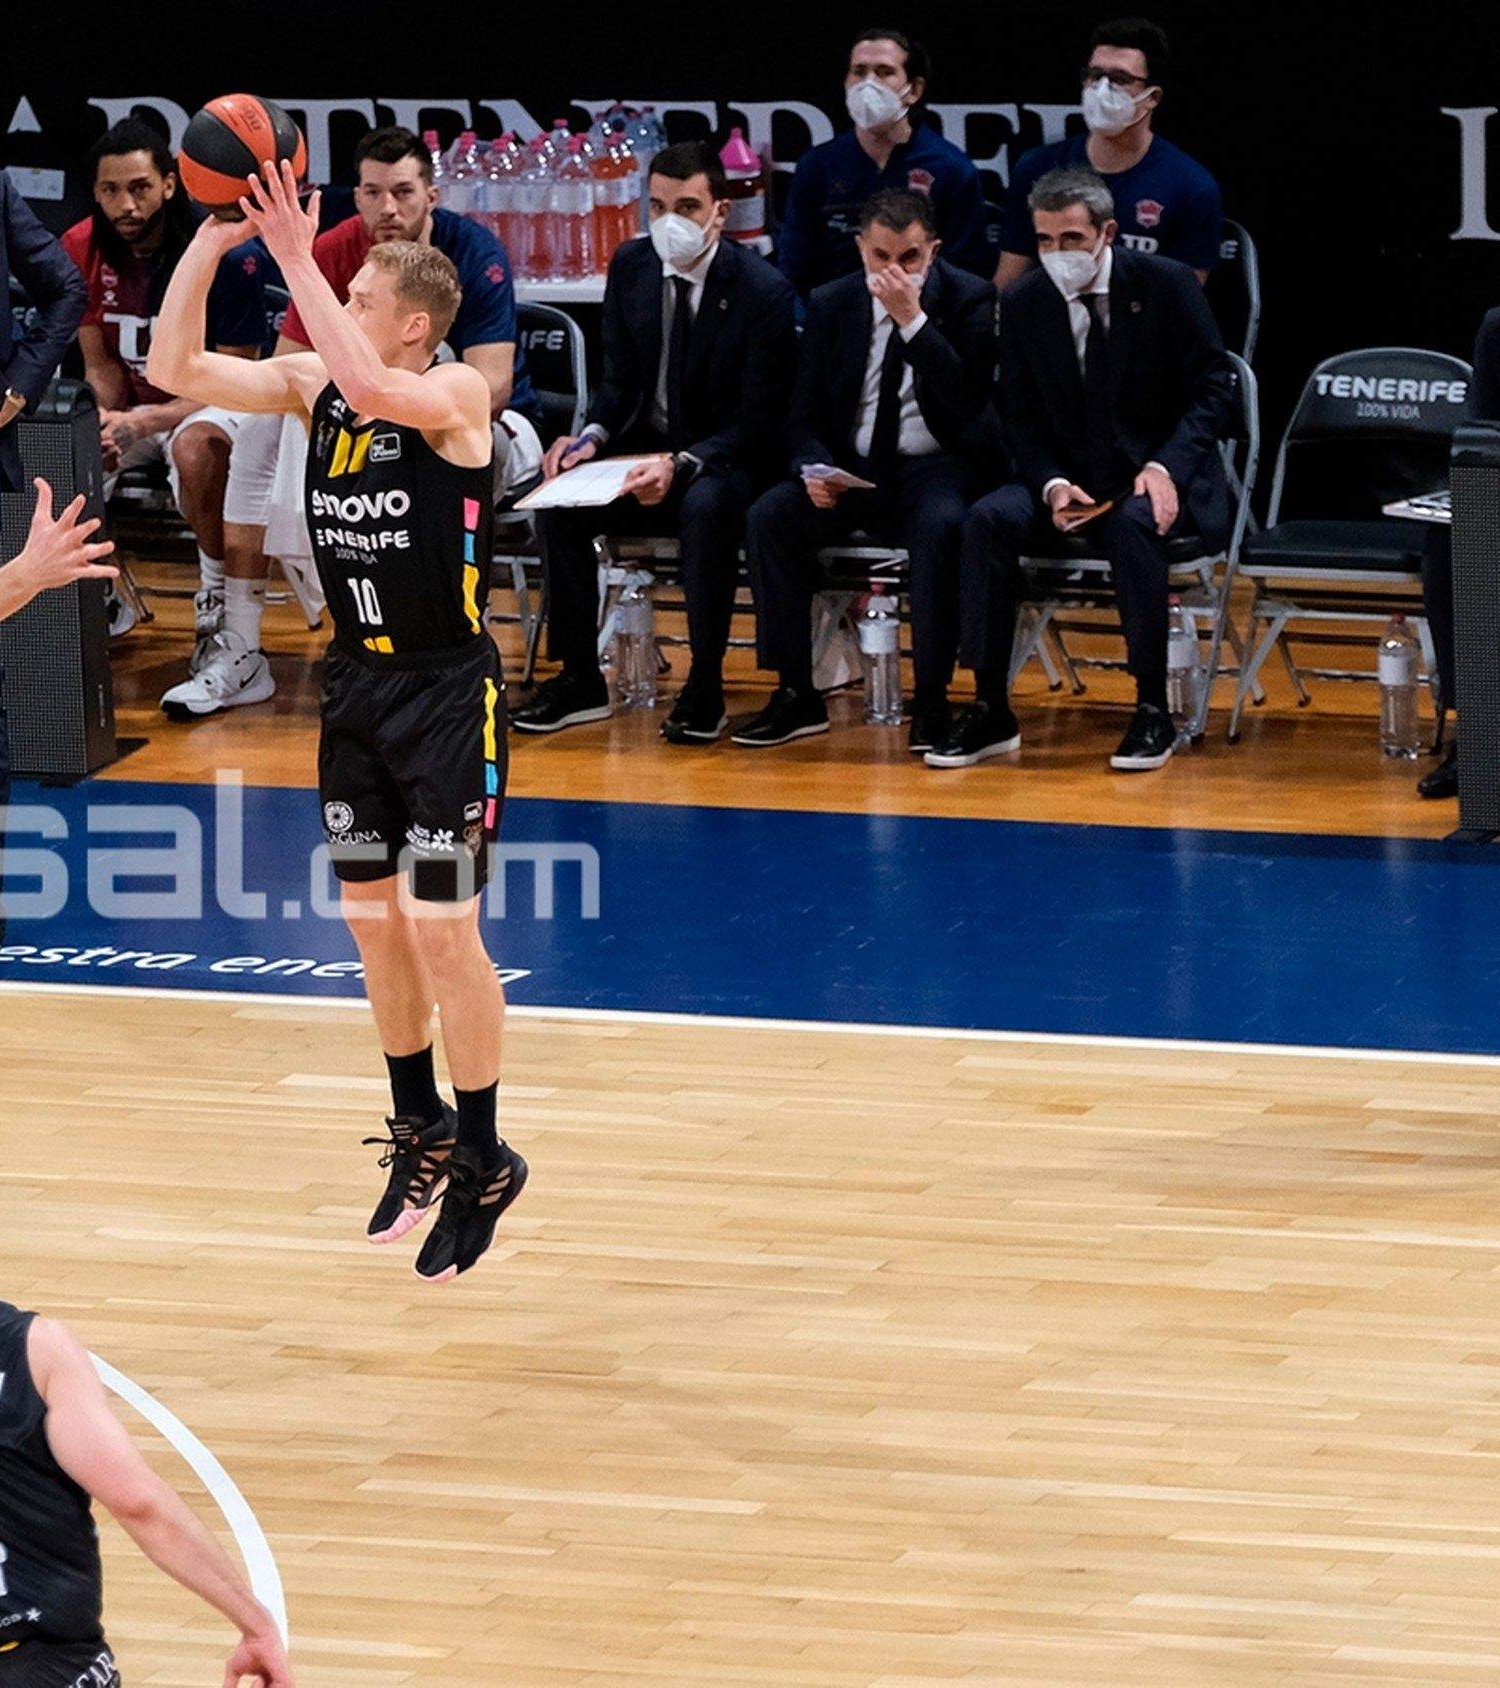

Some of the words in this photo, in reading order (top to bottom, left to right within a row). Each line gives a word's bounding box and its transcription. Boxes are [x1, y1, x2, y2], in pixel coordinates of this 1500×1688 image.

[102, 312, 165, 363] T
[1314, 373, 1468, 404] TENERIFE
[1356, 402, 1389, 418] 100%
[347, 576, 384, 626] 10
